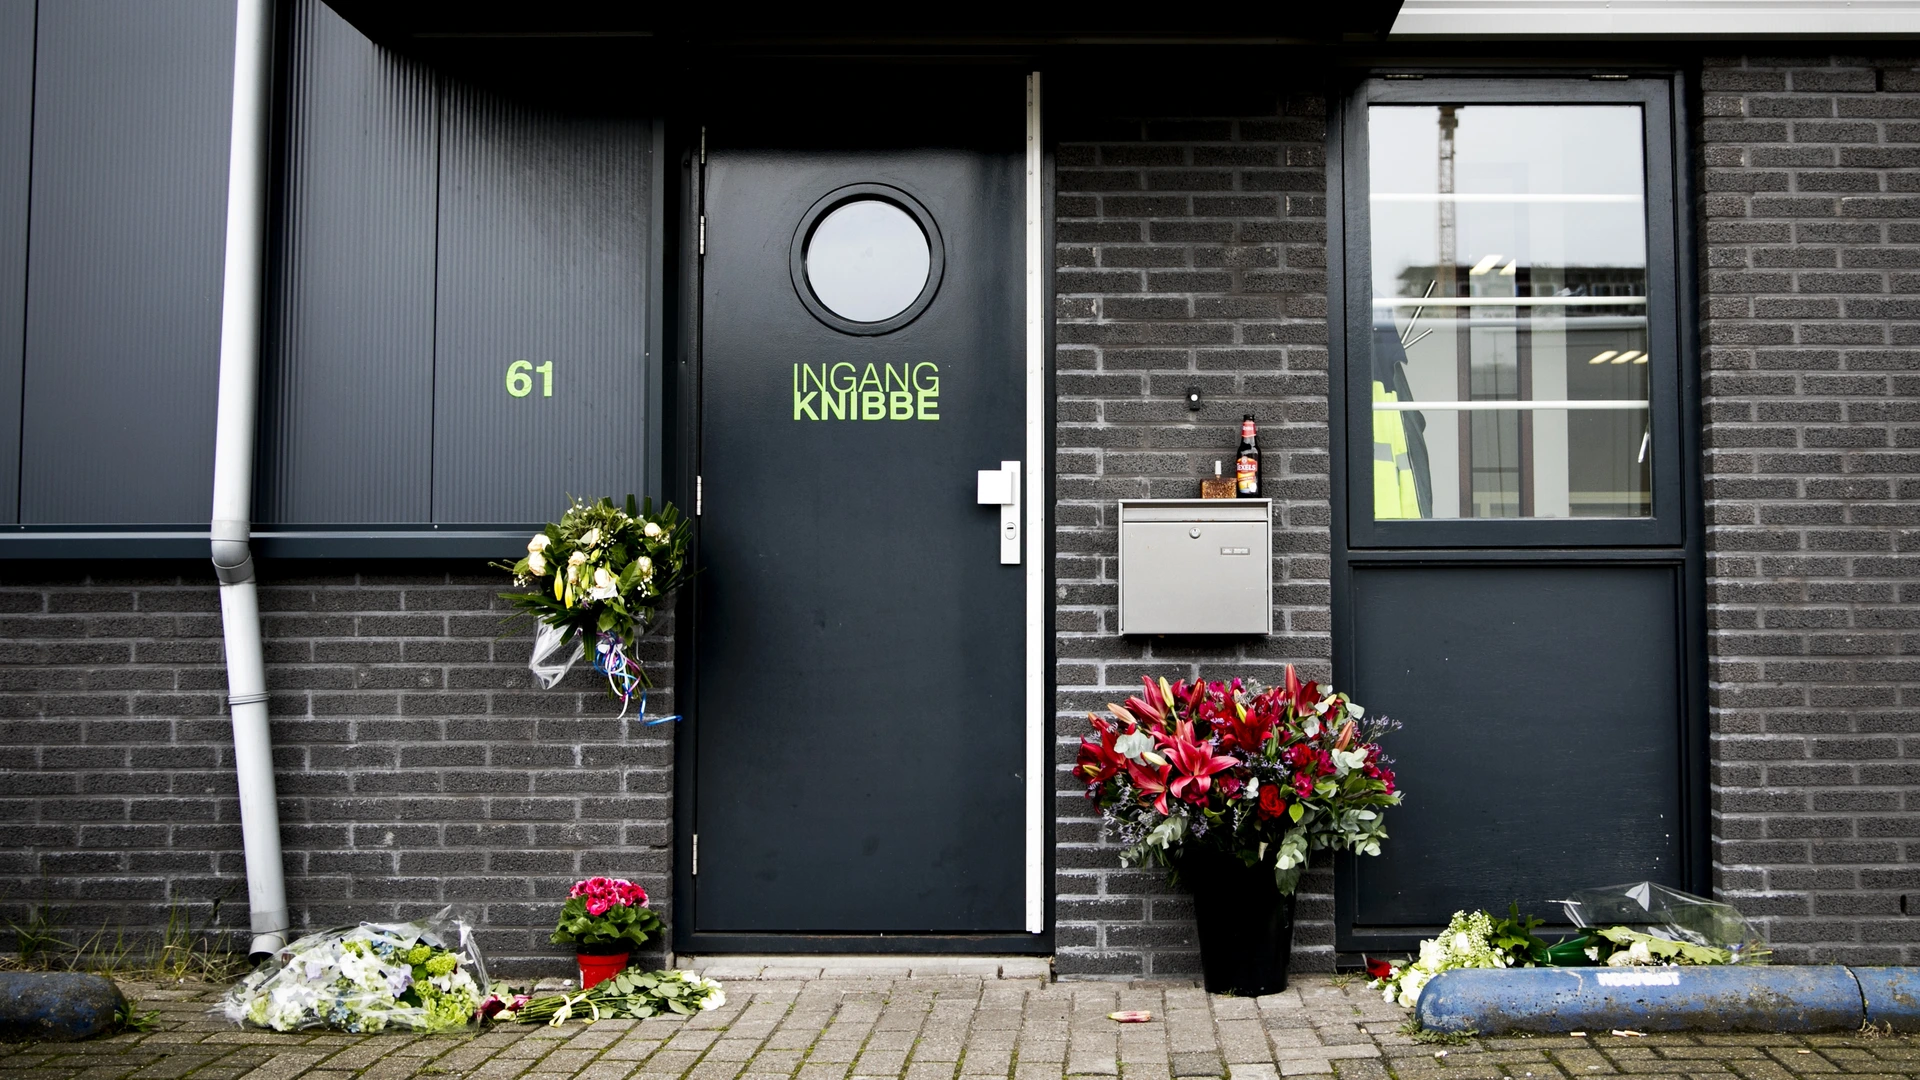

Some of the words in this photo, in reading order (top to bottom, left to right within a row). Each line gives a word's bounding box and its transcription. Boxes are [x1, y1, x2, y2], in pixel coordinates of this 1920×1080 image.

[506, 360, 553, 397] 61
[793, 362, 939, 394] INGANG
[793, 391, 940, 420] KNIBBE
